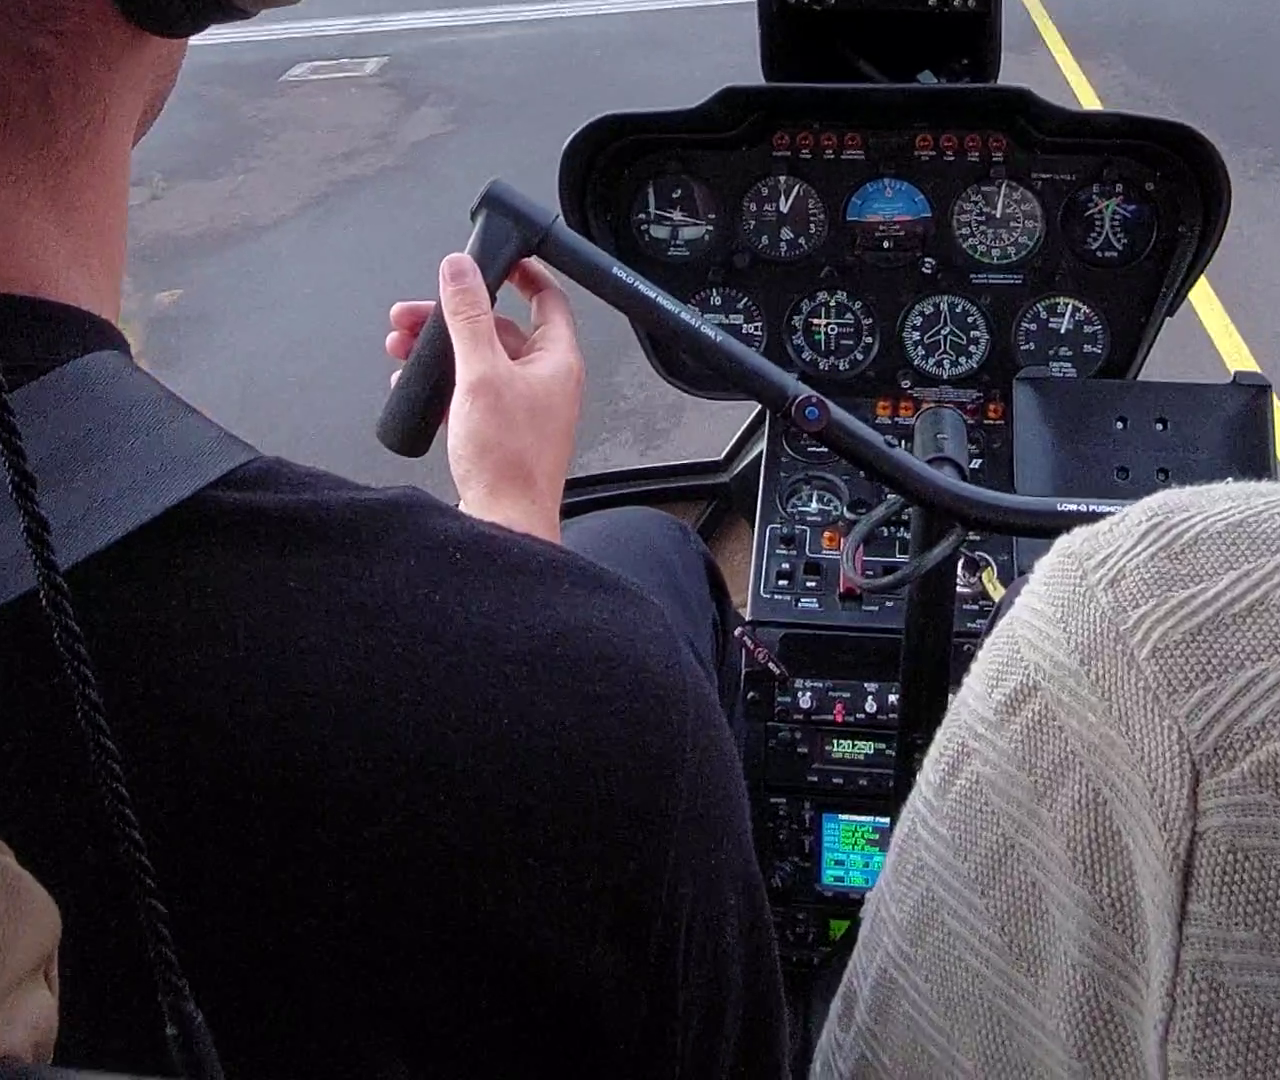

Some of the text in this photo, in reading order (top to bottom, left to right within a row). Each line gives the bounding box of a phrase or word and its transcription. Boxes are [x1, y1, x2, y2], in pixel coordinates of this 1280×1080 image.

[761, 187, 769, 196] 9
[761, 235, 769, 245] 6
[780, 241, 787, 251] 5
[611, 266, 634, 284] SOLO
[633, 281, 657, 300] FROM
[655, 295, 680, 314] RIGHT
[679, 311, 702, 328] SEAT
[700, 323, 723, 343] ONLY
[710, 296, 721, 306] 10
[741, 324, 754, 334] 20
[1056, 502, 1088, 512] LOW-G
[831, 739, 874, 754] 120.250
